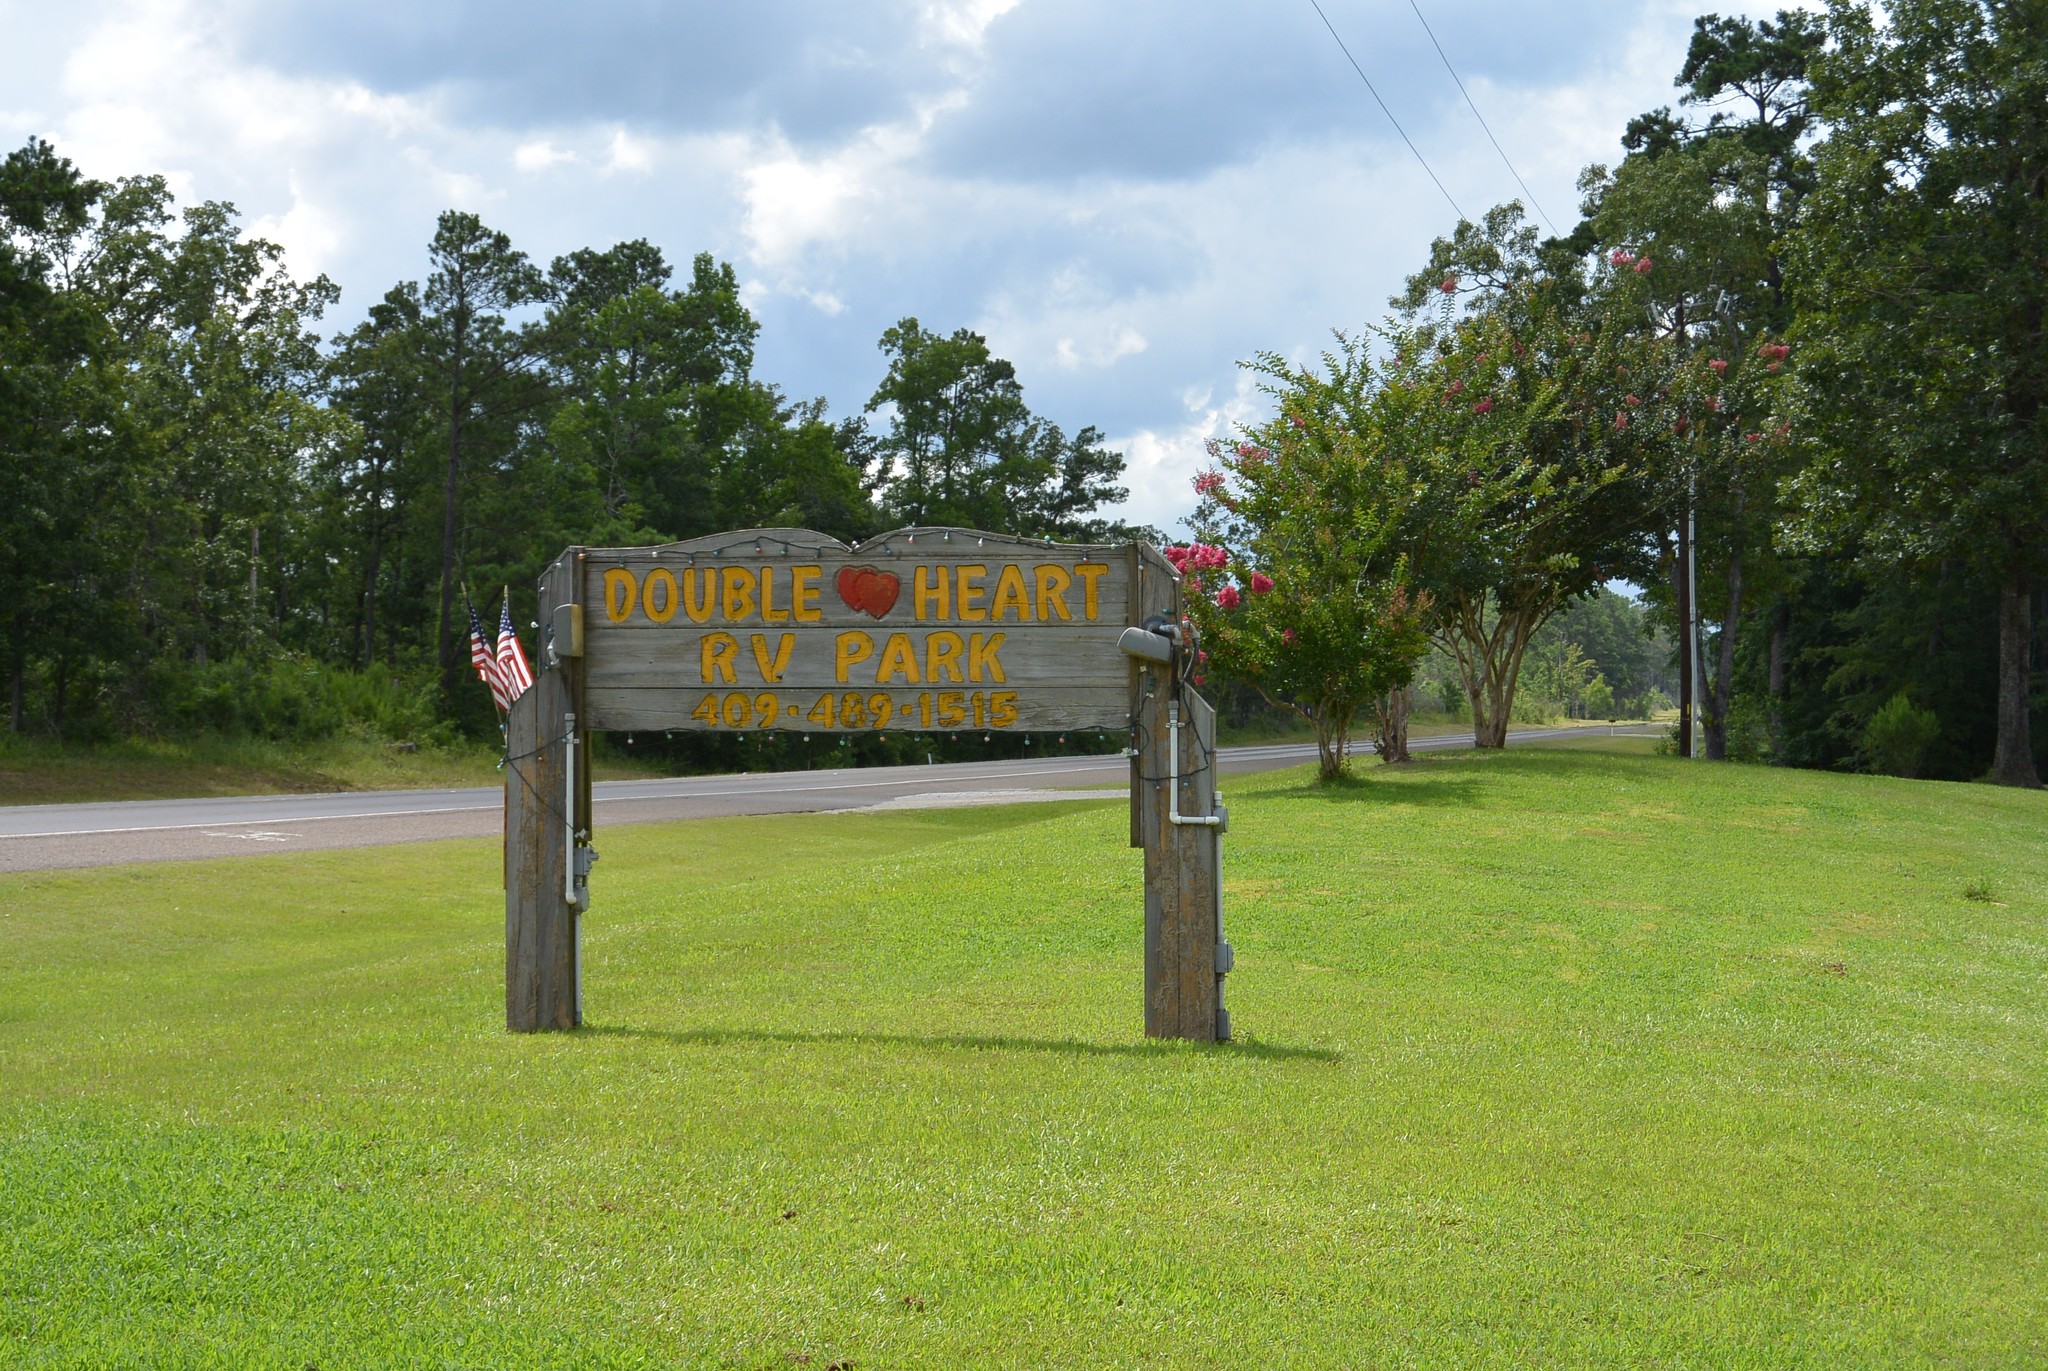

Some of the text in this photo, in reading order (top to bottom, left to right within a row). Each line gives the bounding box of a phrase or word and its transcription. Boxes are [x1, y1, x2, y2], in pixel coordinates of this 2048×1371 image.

[603, 563, 1110, 624] DOUBLE HEART
[699, 629, 1008, 685] RV PARK
